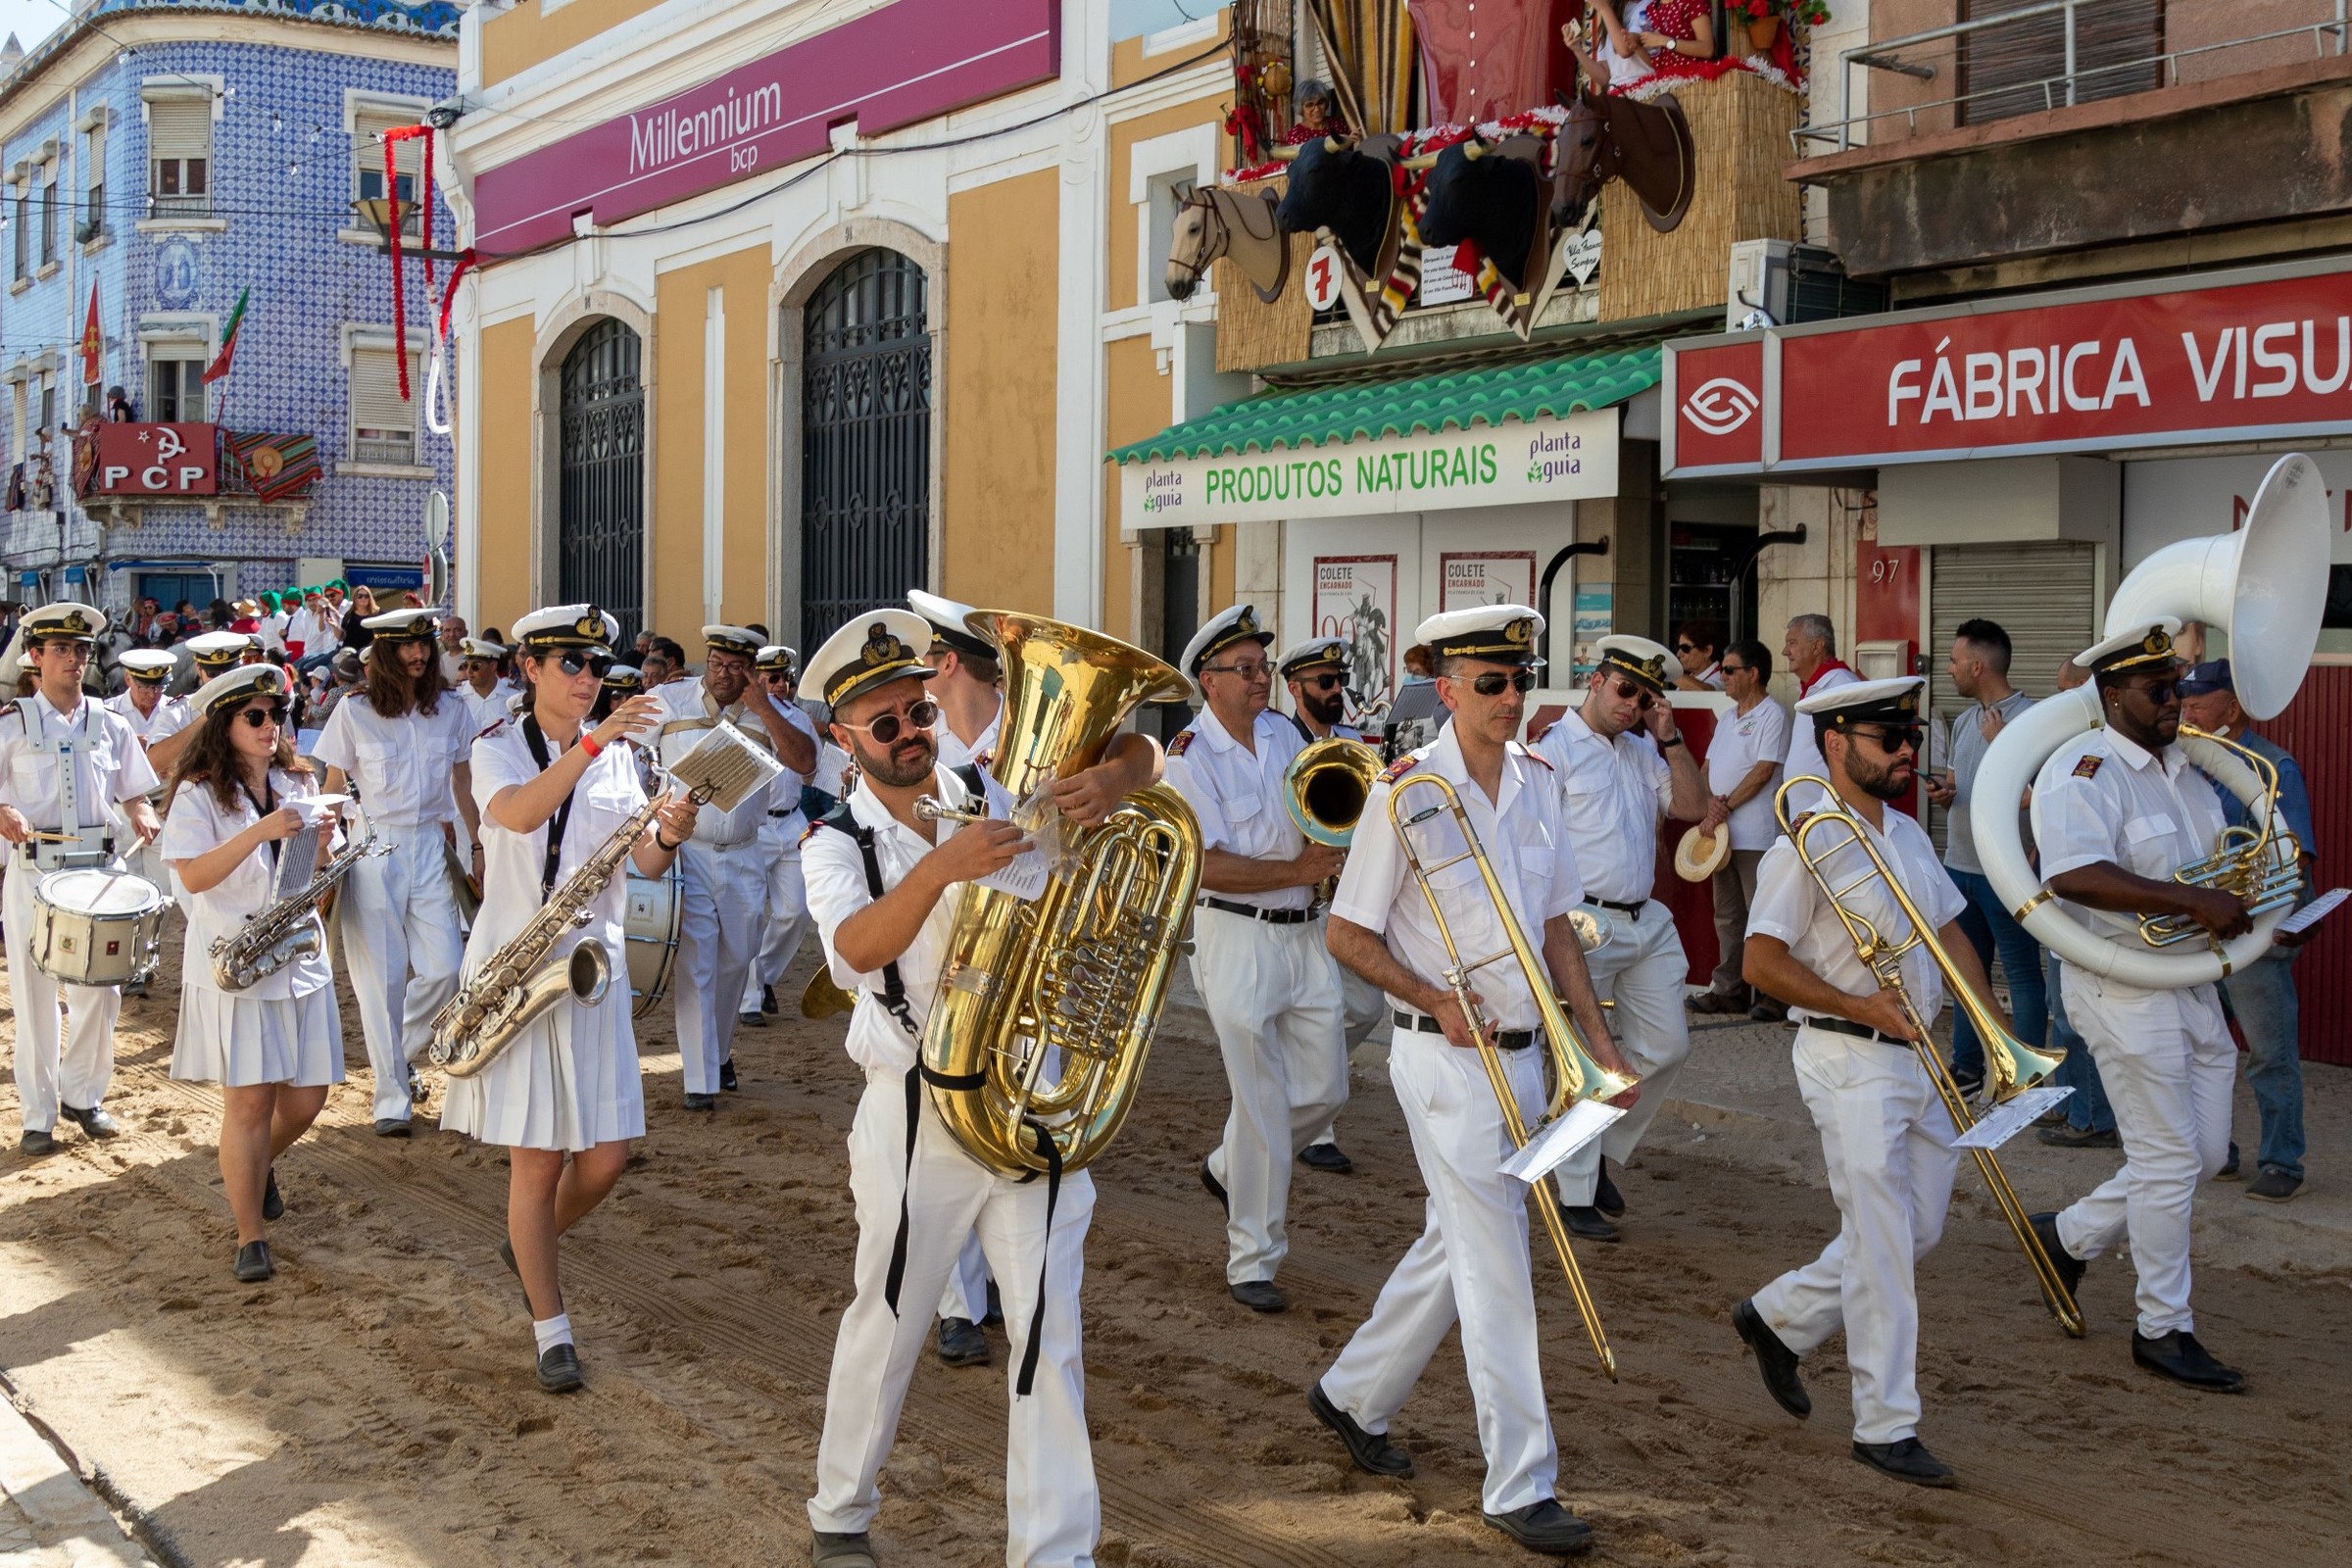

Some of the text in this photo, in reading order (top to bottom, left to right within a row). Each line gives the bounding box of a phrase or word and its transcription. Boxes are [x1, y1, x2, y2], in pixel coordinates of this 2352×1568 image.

[629, 82, 781, 174] Millennium
[730, 145, 759, 172] bcp
[1311, 255, 1332, 303] 7
[1888, 316, 2352, 426] FÁBRICA VISU
[1530, 431, 1580, 460] planta
[1146, 468, 1182, 493] planta
[1206, 443, 1497, 506] PRODUTOS NATURAIS
[1544, 454, 1580, 483] guia
[1155, 488, 1182, 513] guia
[1320, 566, 1352, 580] COLETE
[1447, 564, 1485, 577] COLETE
[1447, 579, 1485, 588] ENCARNADO
[1873, 559, 1899, 584] 97
[1319, 581, 1352, 590] ENCARNADO
